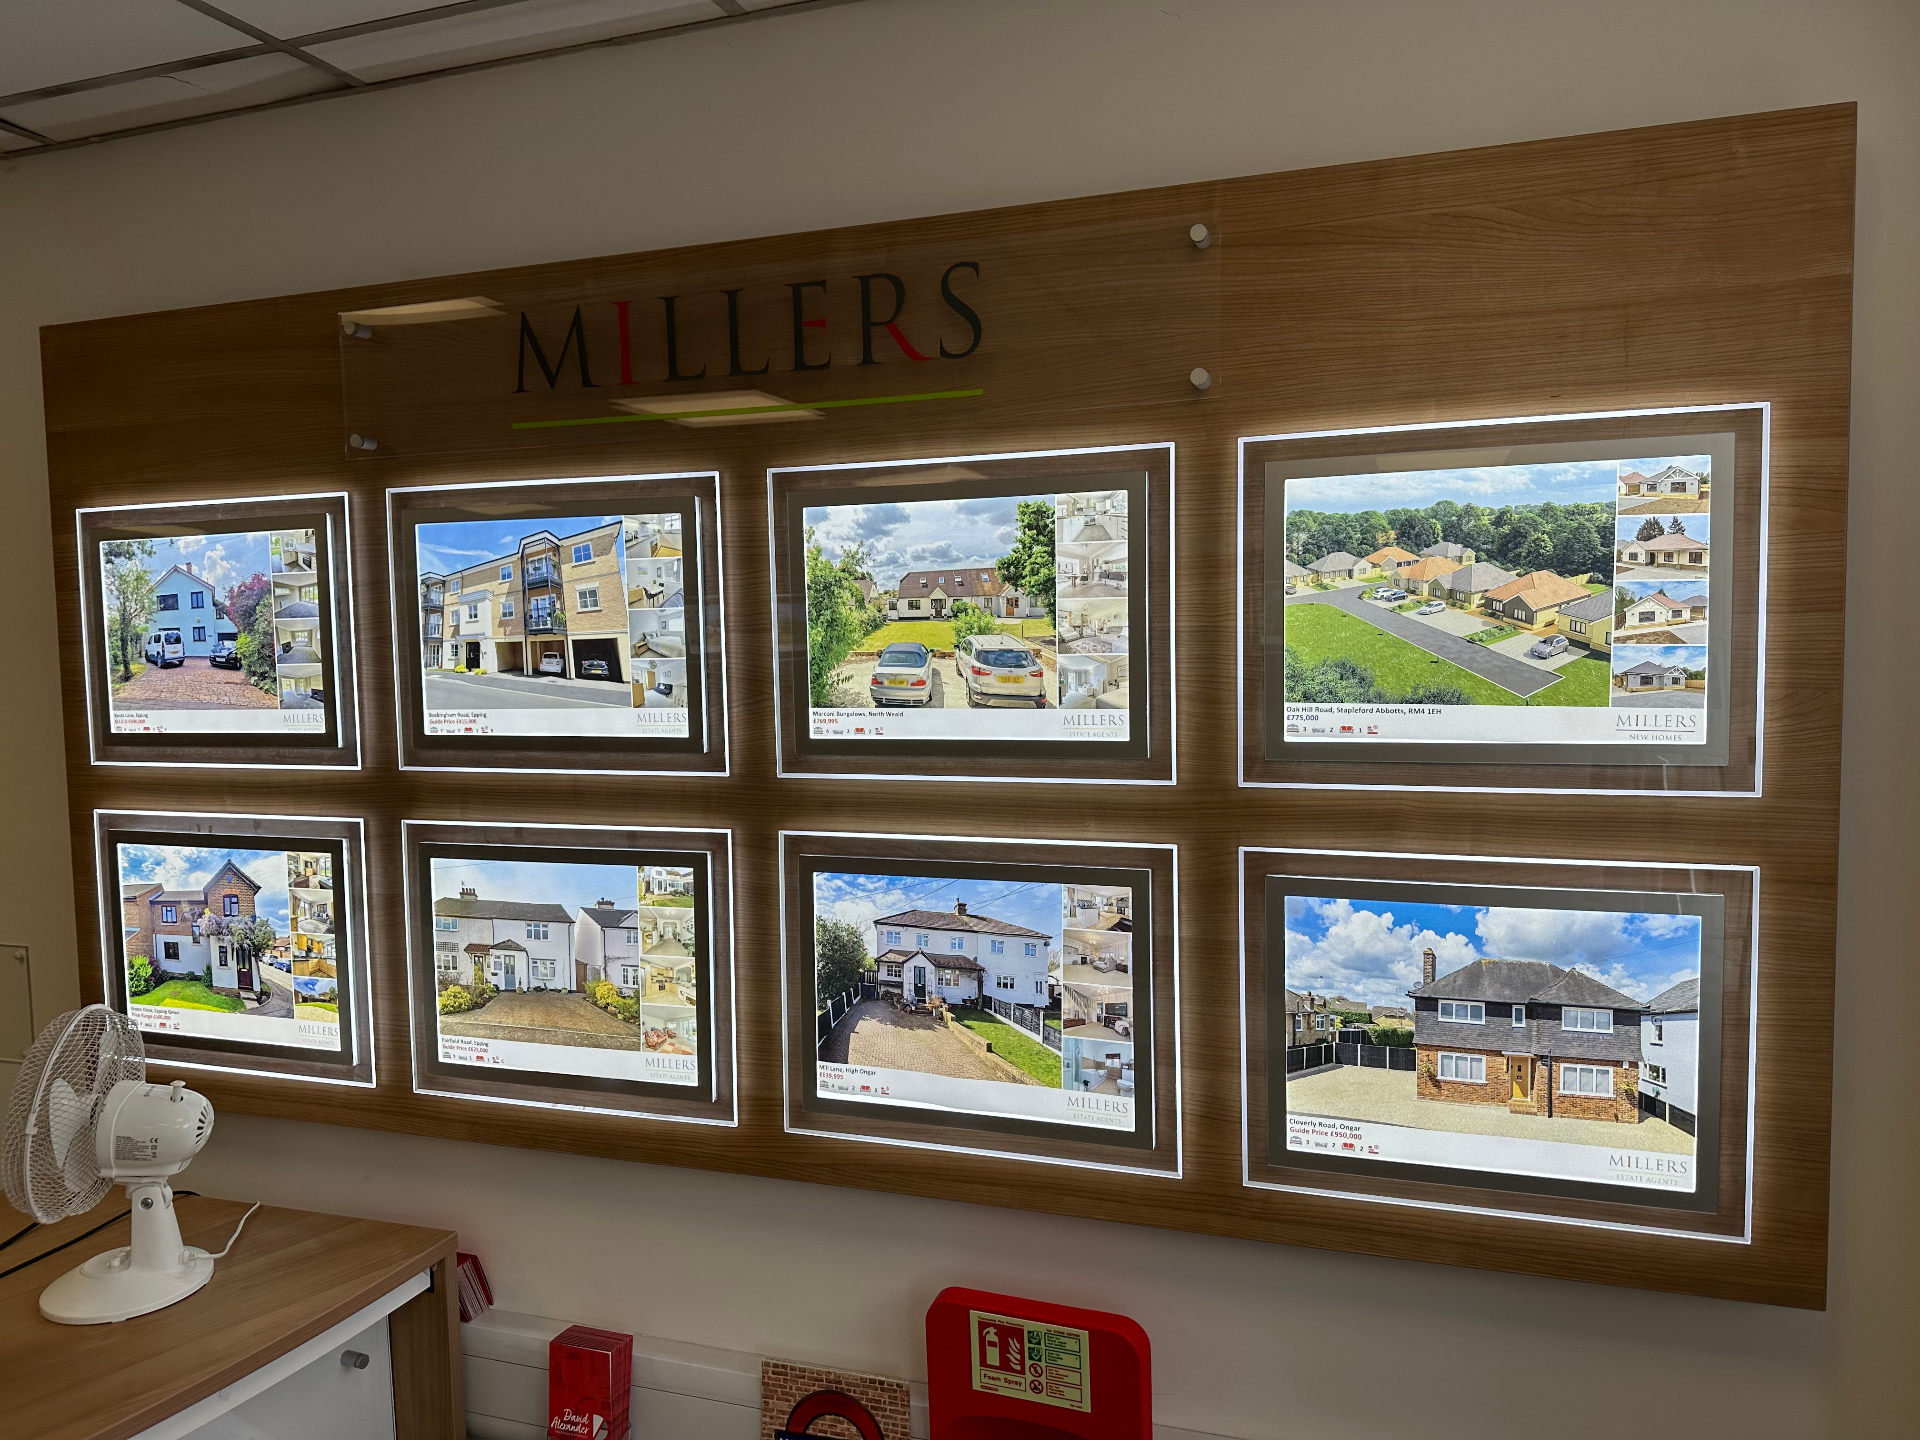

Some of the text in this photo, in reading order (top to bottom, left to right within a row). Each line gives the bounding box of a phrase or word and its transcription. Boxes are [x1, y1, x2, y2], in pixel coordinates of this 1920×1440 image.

[512, 261, 982, 393] MILLERS
[637, 712, 687, 723] MILLERS
[1336, 707, 1374, 715] Stapleford
[1375, 707, 1407, 715] Abbotts,
[283, 714, 324, 723] MILLERS
[1063, 714, 1124, 726] MILLERS
[1616, 714, 1697, 728] MILLERS
[298, 1025, 339, 1036] MILLERS
[645, 1057, 696, 1070] MILLERS
[859, 1068, 876, 1076] Ongar
[1067, 1096, 1128, 1113] MILLERS
[1096, 1116, 1122, 1124] AGENTS
[1289, 1118, 1361, 1132] Cloverly Road, Ongar
[1289, 1126, 1310, 1134] Guide
[1330, 1130, 1362, 1140] £950,000
[1609, 1154, 1687, 1174] MILLERS
[1616, 1174, 1678, 1186] ESTATE AGENTS
[983, 1373, 1022, 1387] Foam Spray
[563, 1408, 590, 1424] David
[550, 1415, 590, 1435] Alexander
